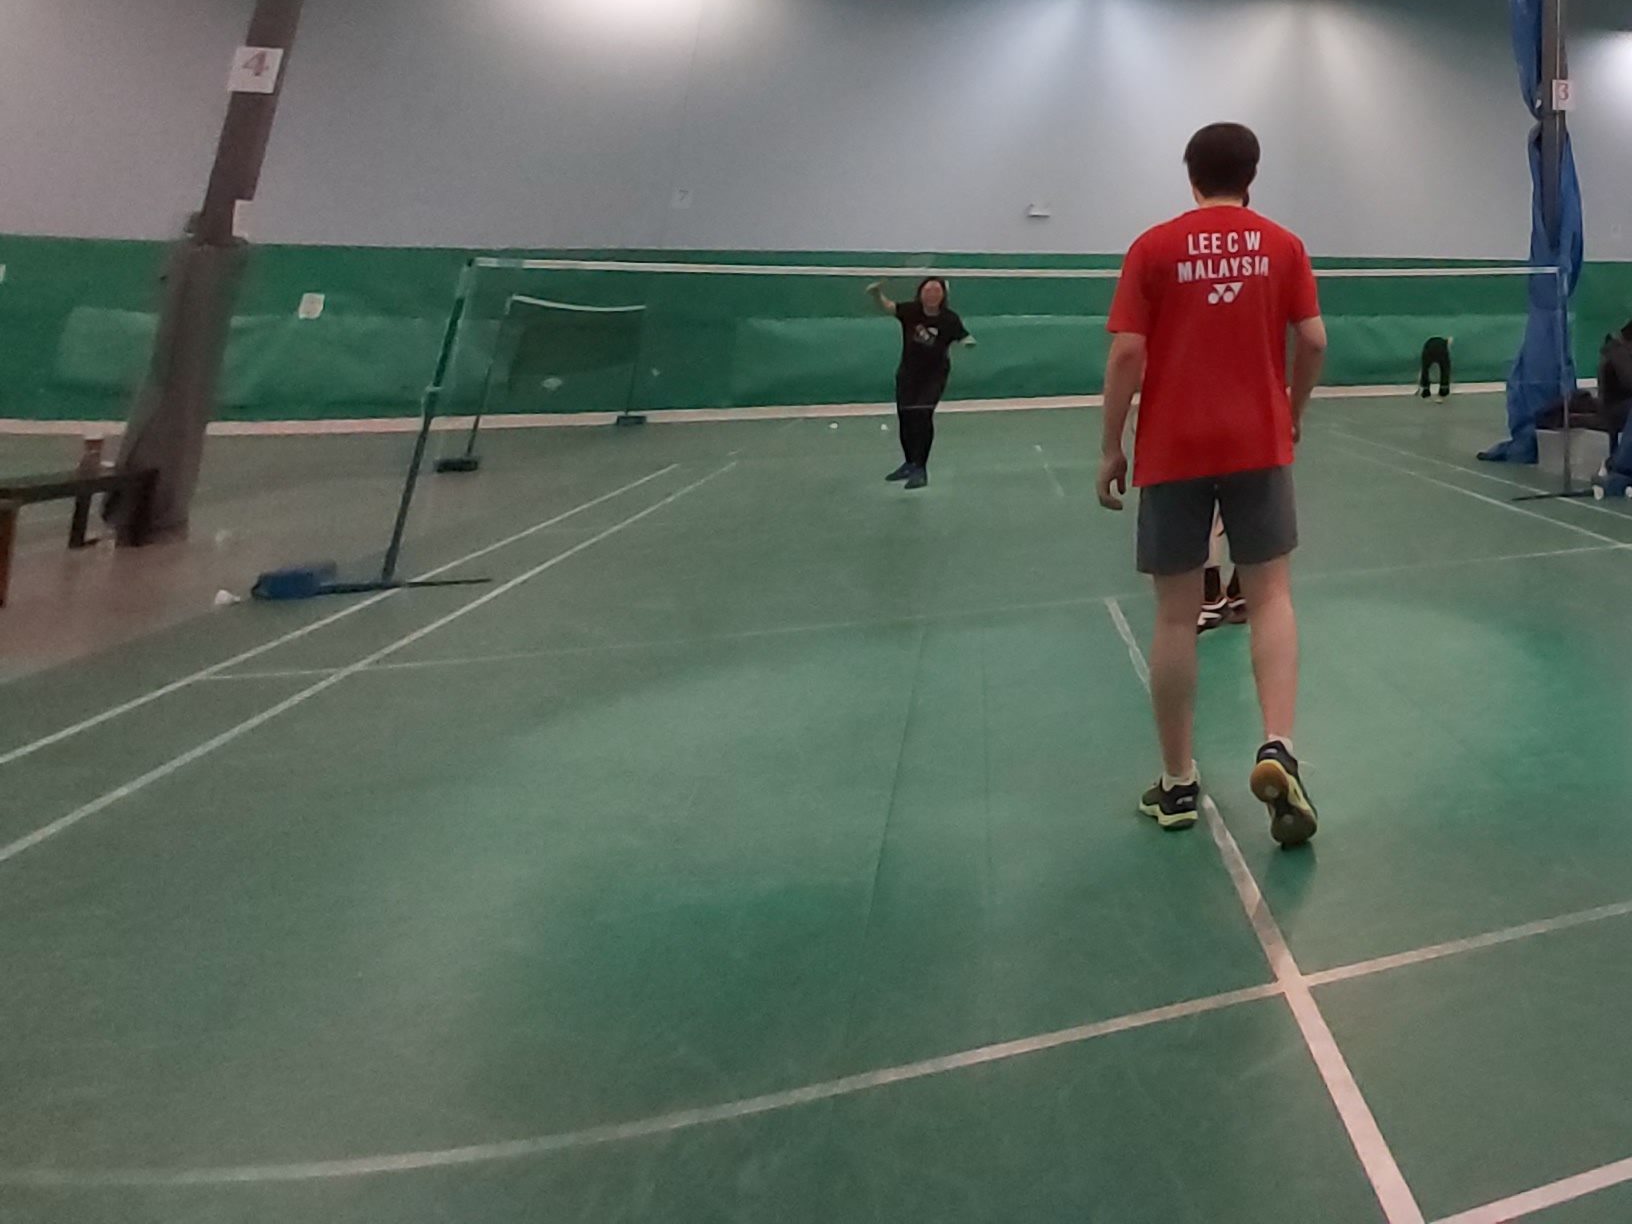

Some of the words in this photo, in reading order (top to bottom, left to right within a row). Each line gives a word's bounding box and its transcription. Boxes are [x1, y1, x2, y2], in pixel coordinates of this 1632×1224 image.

[242, 50, 269, 77] 4
[1559, 82, 1569, 101] 3
[1187, 232, 1223, 255] LEE
[1227, 231, 1239, 253] C
[1244, 230, 1261, 251] W
[1177, 255, 1269, 283] MALAYSIA
